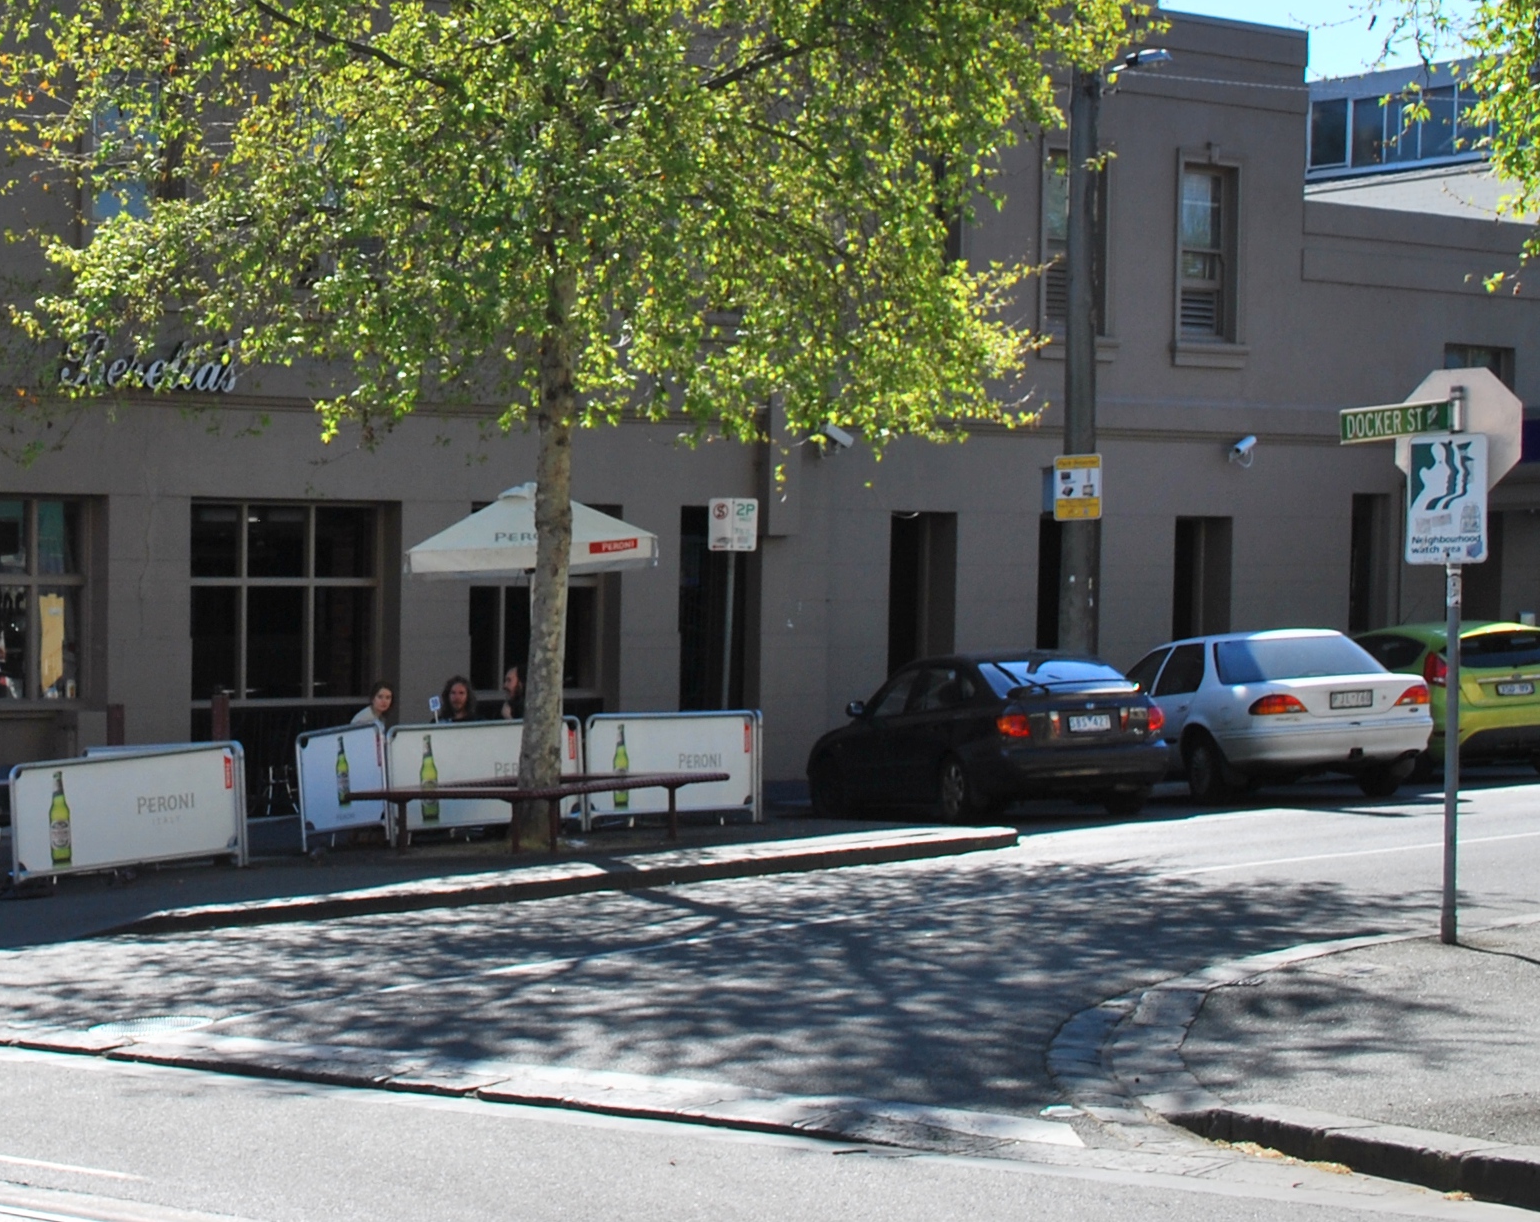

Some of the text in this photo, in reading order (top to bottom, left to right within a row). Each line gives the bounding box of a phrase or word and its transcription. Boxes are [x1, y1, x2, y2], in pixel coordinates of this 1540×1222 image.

[1346, 407, 1423, 438] DOCKER ST
[736, 503, 755, 516] 2P
[1411, 534, 1482, 545] Neighbourhood
[601, 540, 635, 552] PERONI
[1411, 544, 1461, 554] watch area
[678, 753, 722, 769] PERONI
[137, 792, 195, 815] PERONI
[152, 815, 181, 826] ITALY
